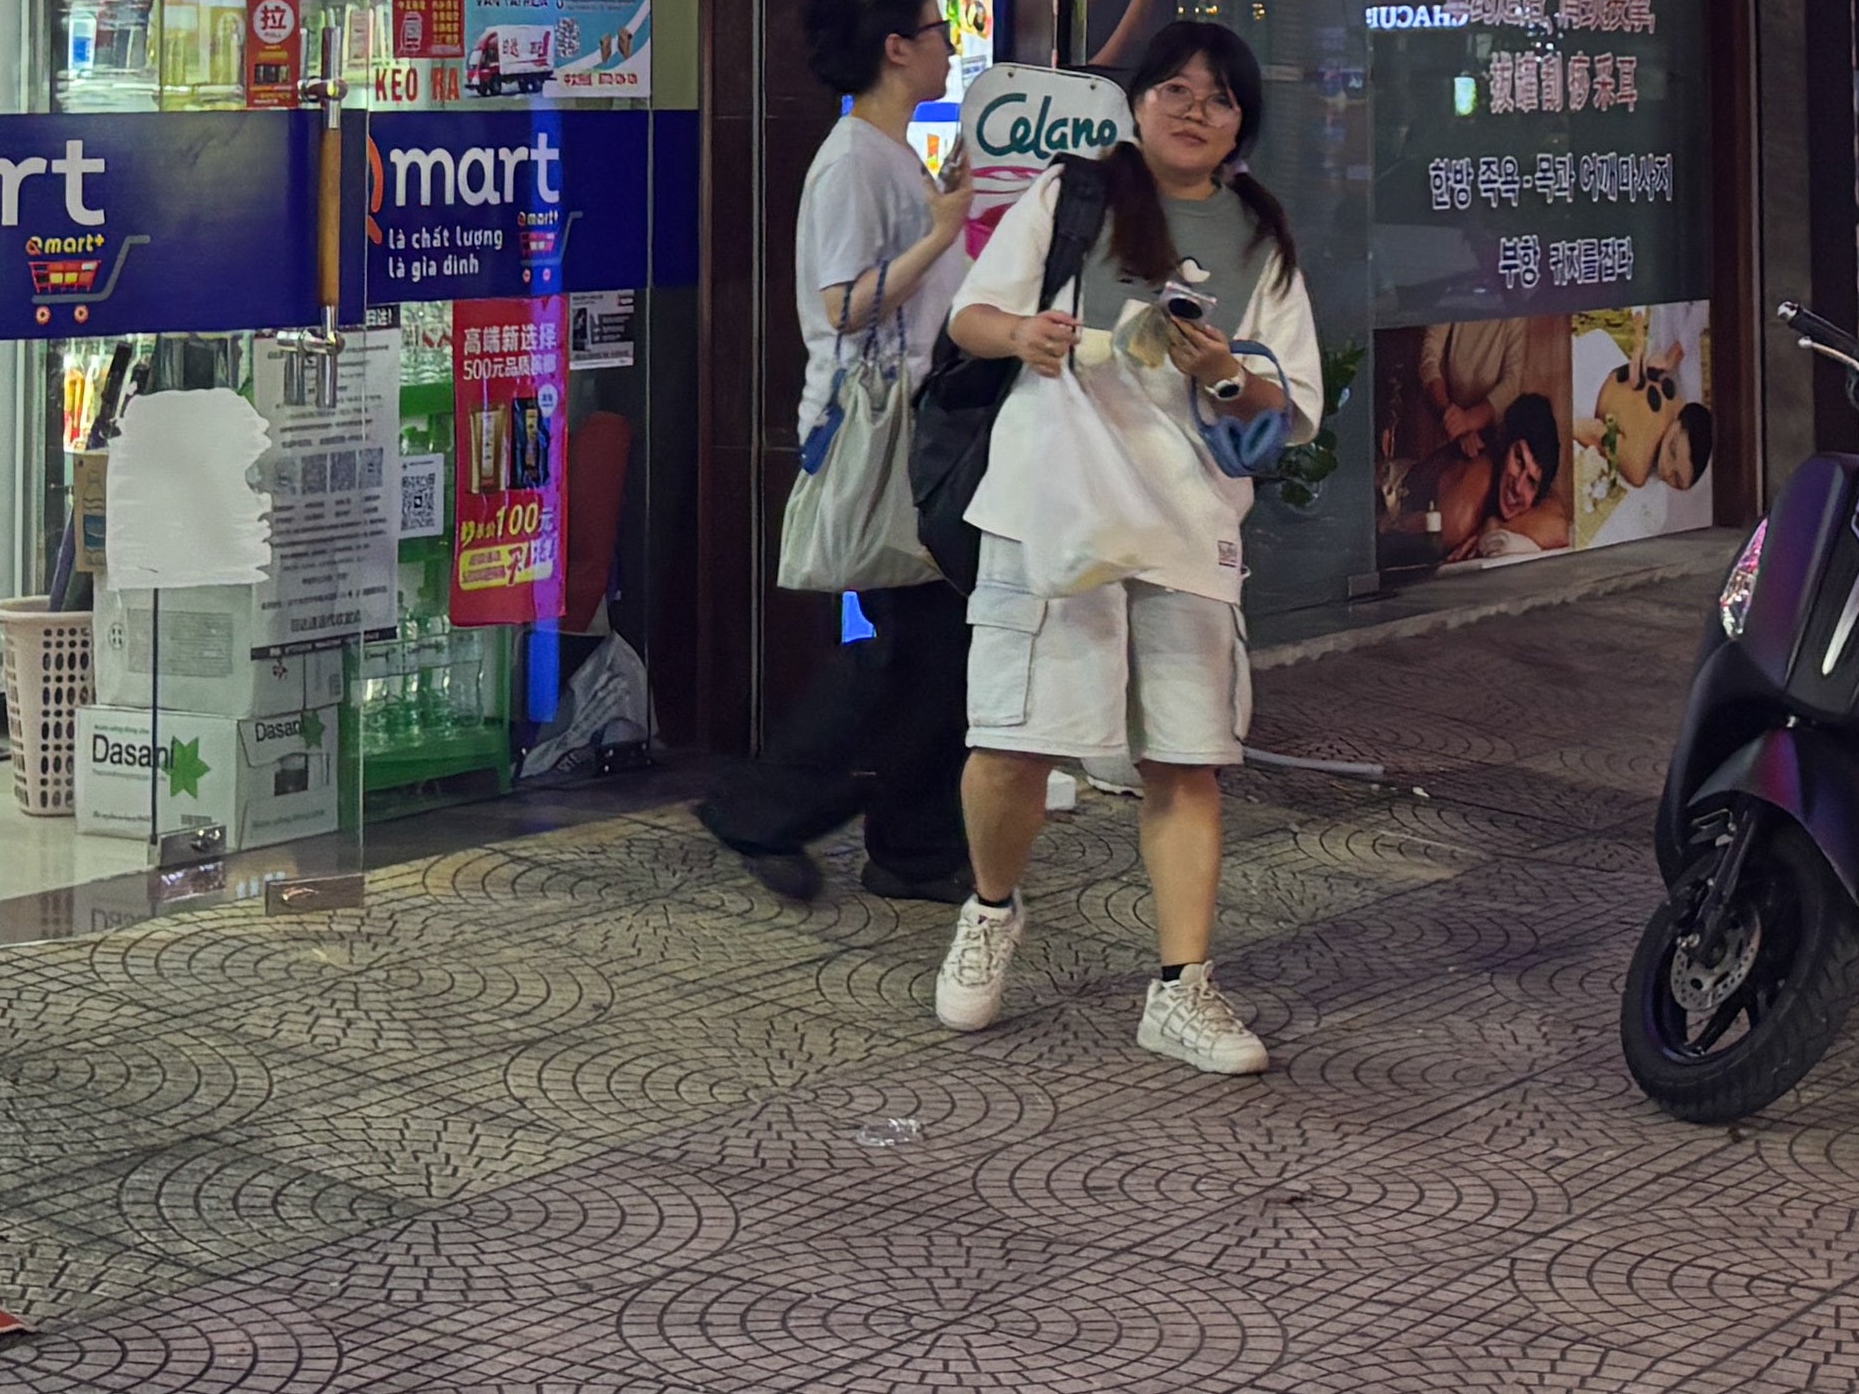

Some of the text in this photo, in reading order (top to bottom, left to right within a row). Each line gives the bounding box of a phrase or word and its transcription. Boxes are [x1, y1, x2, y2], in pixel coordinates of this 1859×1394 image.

[976, 92, 1119, 160] Celano
[389, 225, 503, 250] là chất lượng
[389, 256, 406, 279] là
